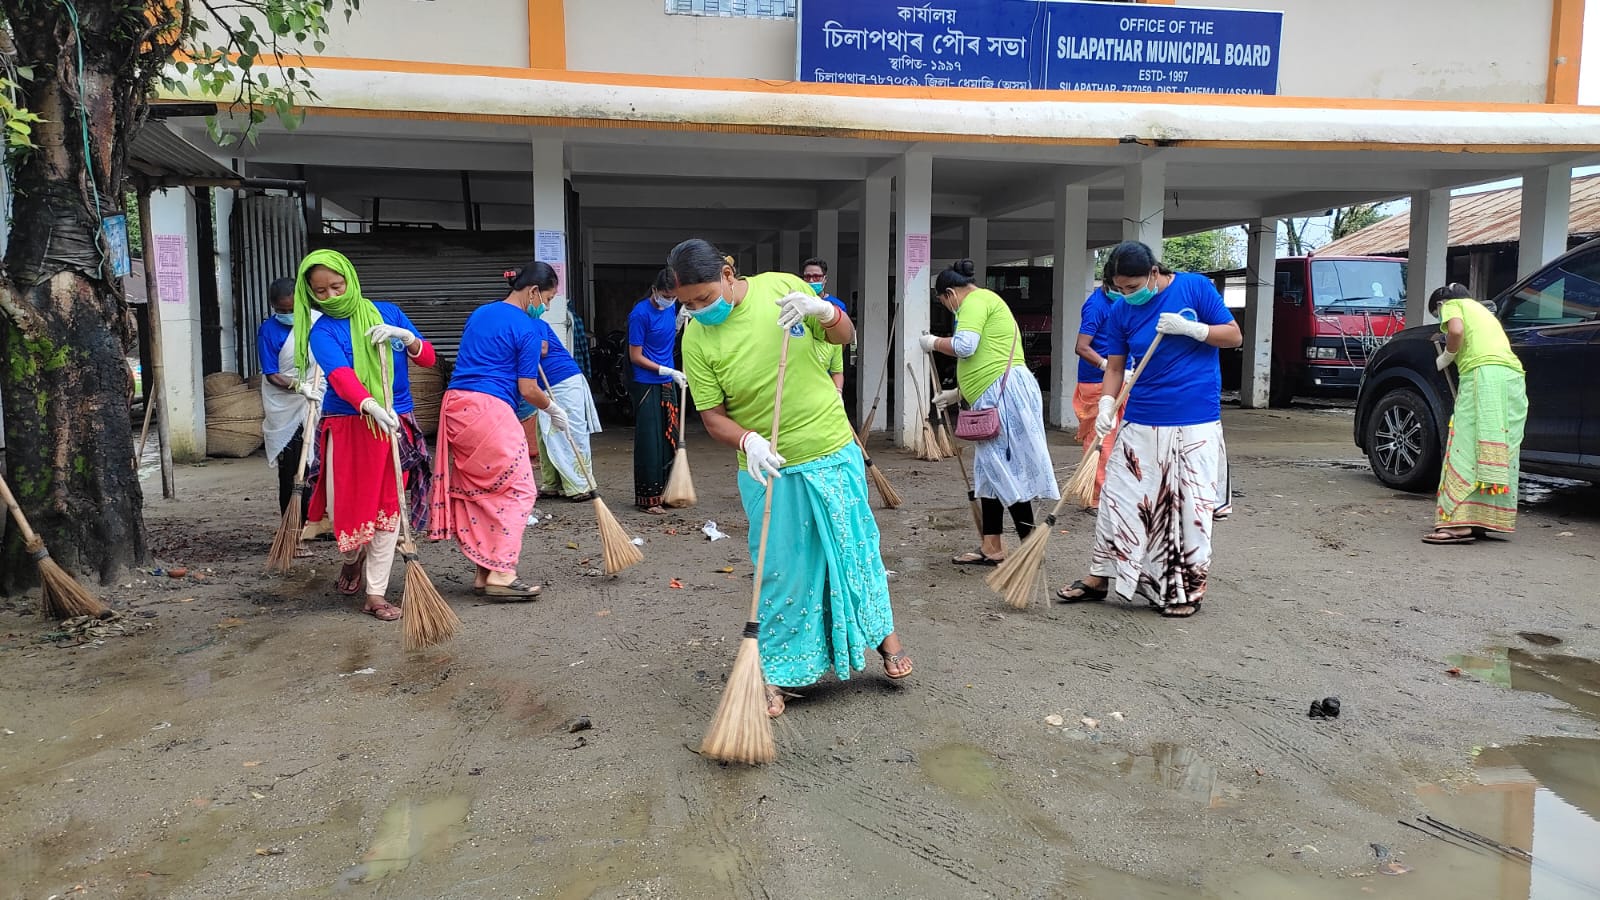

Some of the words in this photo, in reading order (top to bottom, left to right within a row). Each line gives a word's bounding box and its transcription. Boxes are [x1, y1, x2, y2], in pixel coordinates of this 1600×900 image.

[897, 2, 957, 24] কার্যালয়
[1120, 18, 1165, 33] OFFICE
[1169, 20, 1186, 34] OF
[1190, 21, 1214, 35] THE
[823, 20, 924, 53] চিলাপথাৰ
[933, 27, 981, 56] পৌৰ
[988, 36, 1026, 59] সভা
[1057, 36, 1142, 62] SILAPATHAR
[1146, 40, 1221, 65] MUNICIPAL
[1225, 43, 1271, 67] BOARD
[931, 60, 961, 71] ১৯৯৭
[1138, 69, 1166, 81] ESTD-
[1169, 71, 1188, 82] 1997
